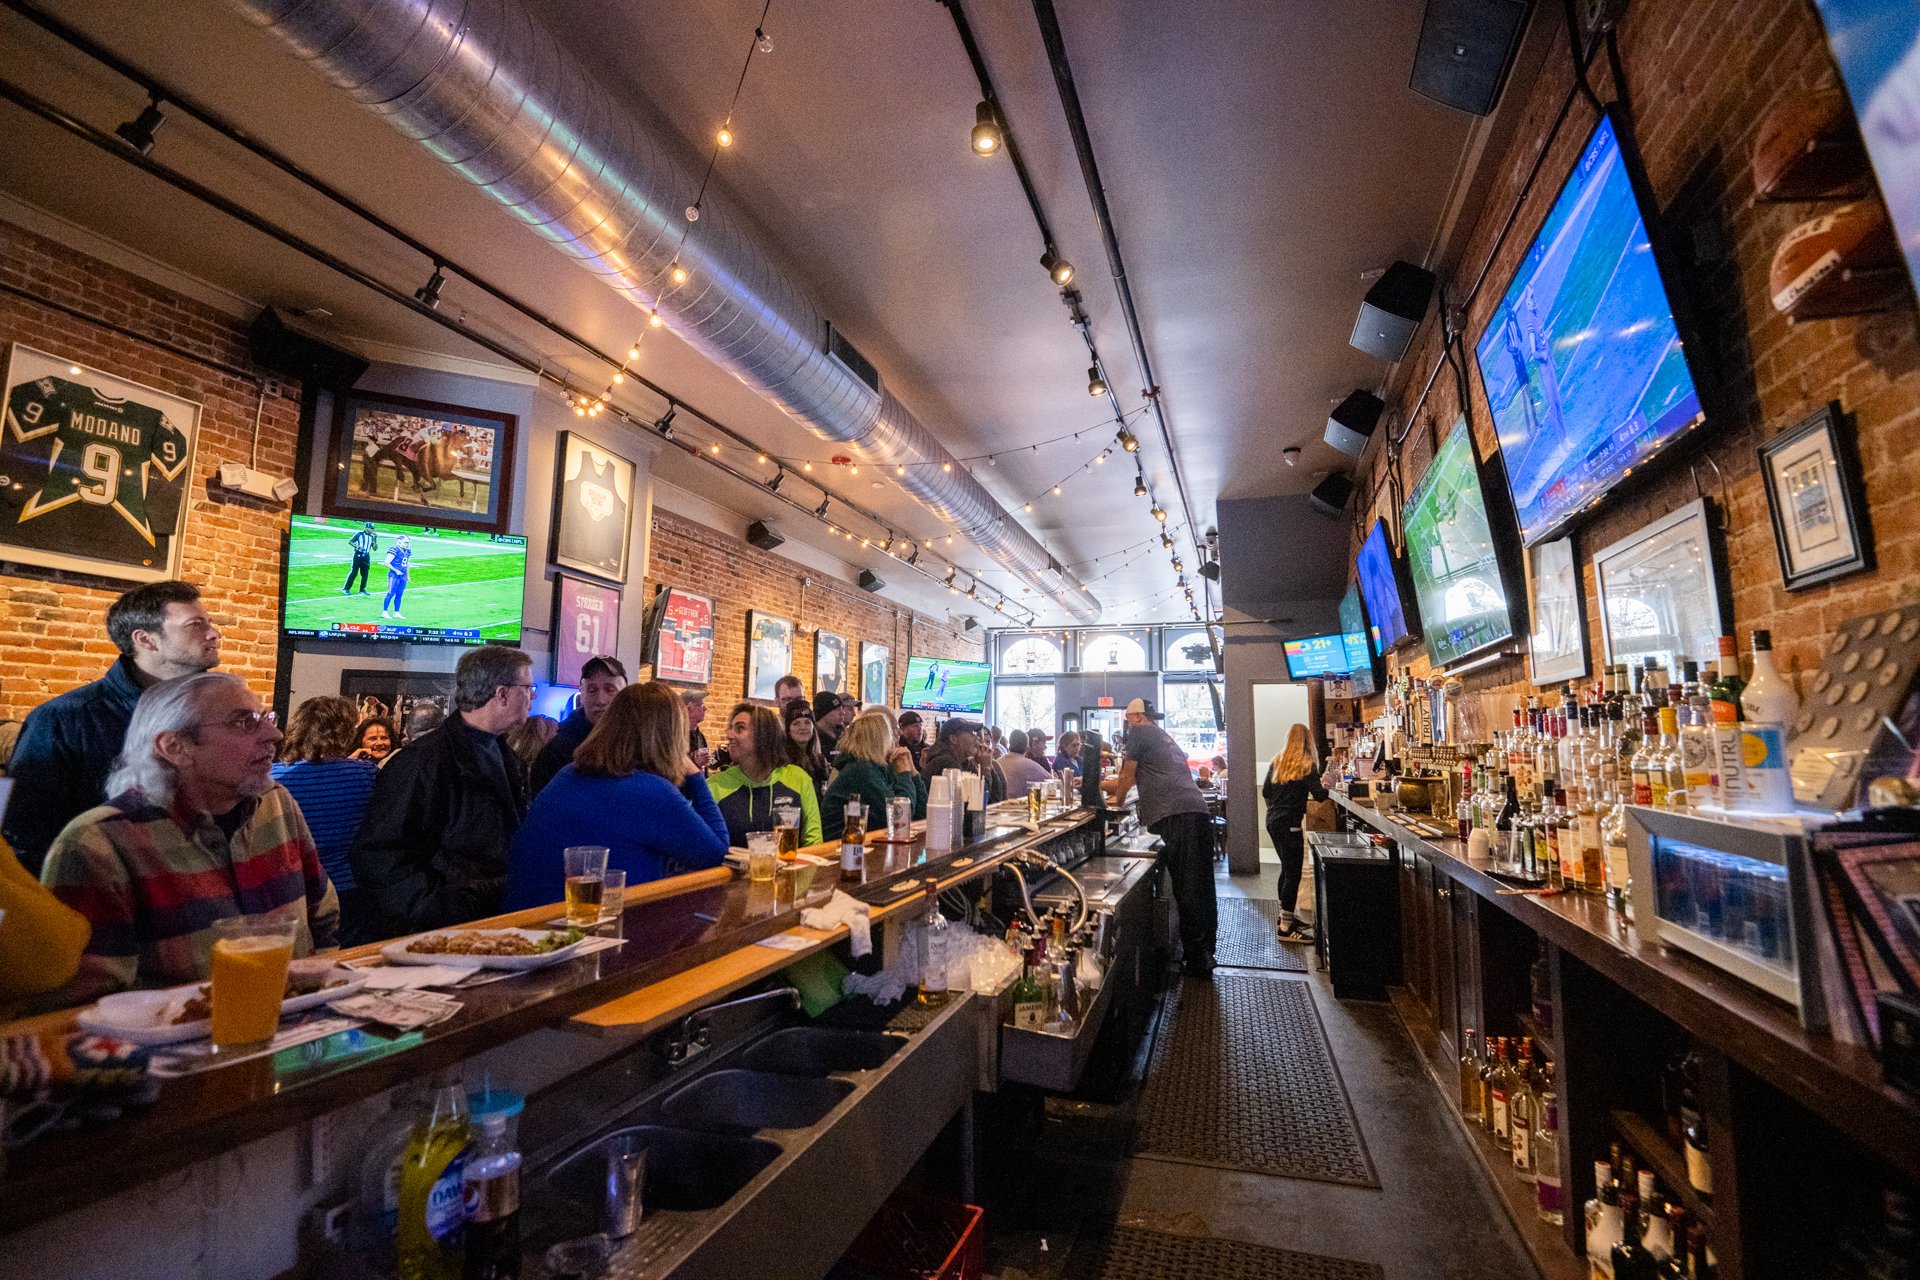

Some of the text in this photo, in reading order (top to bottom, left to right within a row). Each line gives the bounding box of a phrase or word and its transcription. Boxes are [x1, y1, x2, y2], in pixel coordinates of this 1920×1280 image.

[23, 402, 43, 423] 9
[71, 410, 140, 446] MODANO
[162, 442, 176, 462] 9
[78, 442, 122, 506] 9
[575, 613, 600, 655] 61
[1312, 639, 1332, 649] 21+
[432, 1181, 462, 1204] DAW
